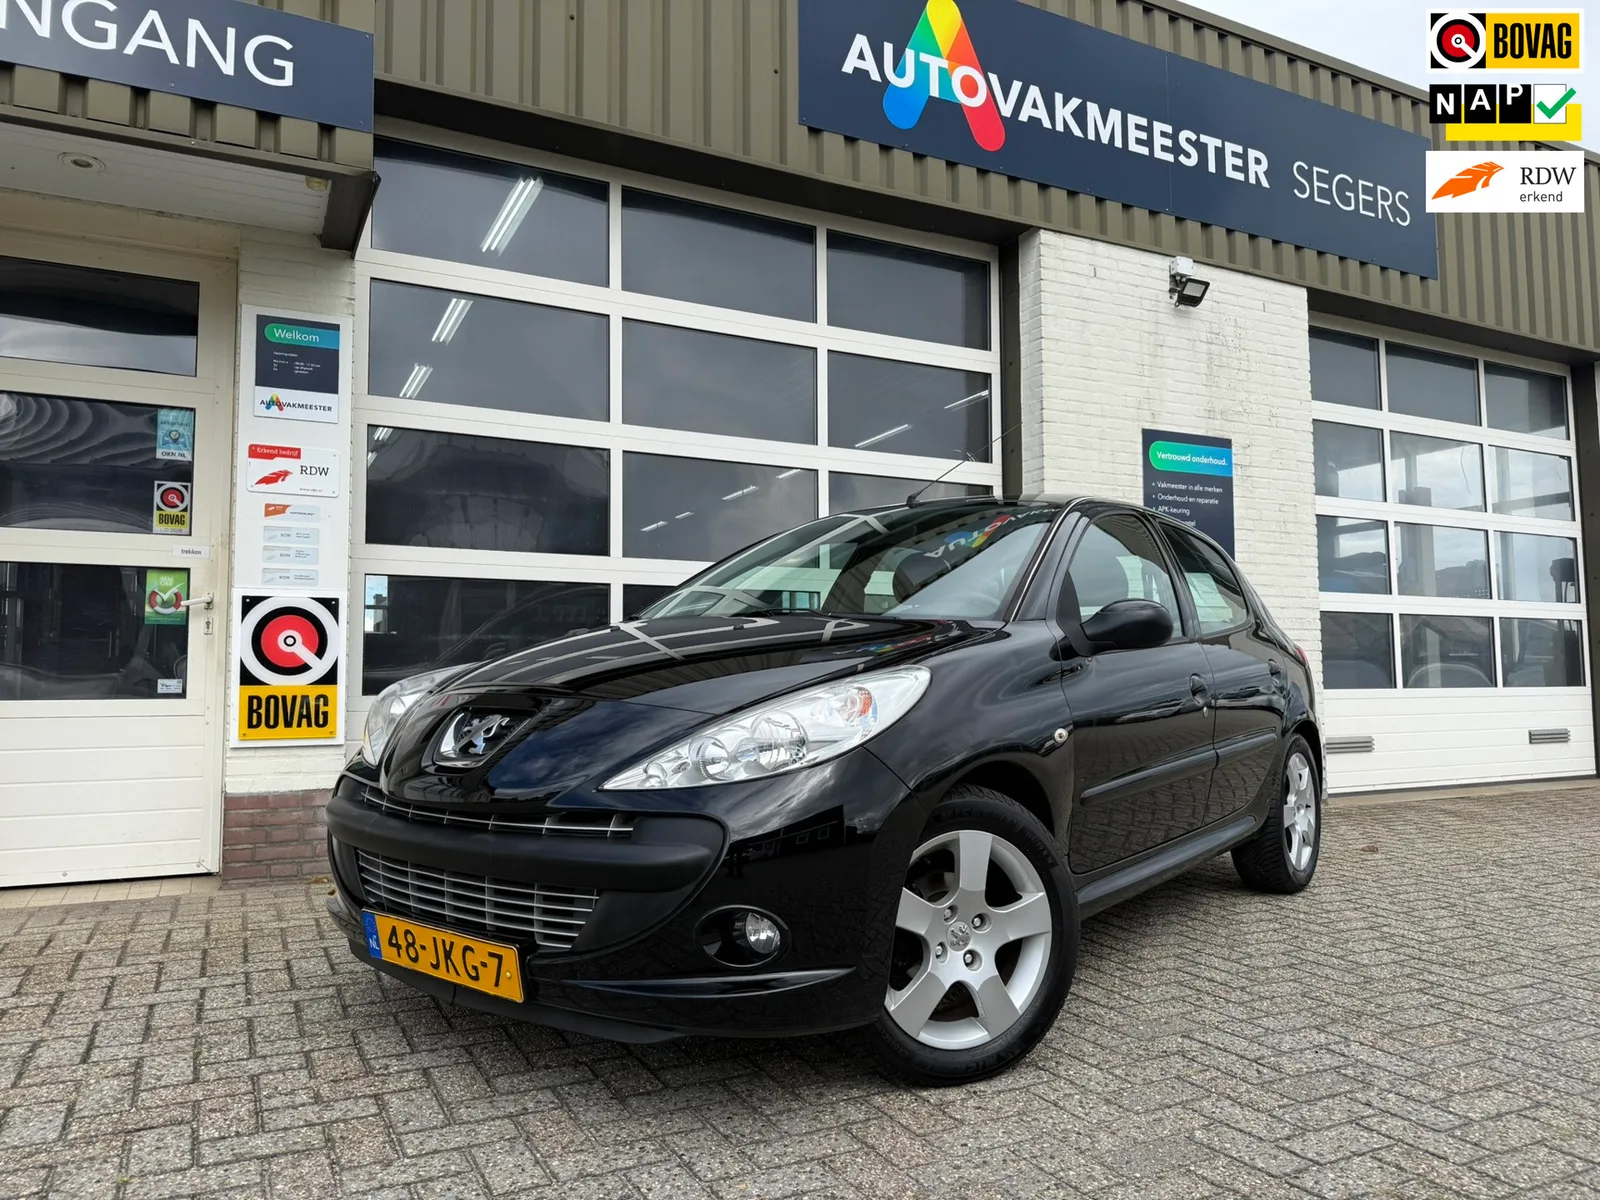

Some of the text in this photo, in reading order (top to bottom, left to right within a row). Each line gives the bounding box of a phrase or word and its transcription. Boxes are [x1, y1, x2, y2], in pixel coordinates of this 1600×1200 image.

[841, 33, 1411, 227] AUTOVAKMEESTER SEGERS
[273, 328, 320, 342] Welkom
[259, 399, 333, 412] AUTOVAKMEESTER
[256, 447, 299, 457] Erkend bedrijf
[1156, 451, 1228, 466] Vertrouwd onderhoud.
[300, 465, 330, 476] RDW
[1156, 481, 1187, 490] Vakmeester
[1157, 493, 1188, 502] Onderhoud
[1196, 497, 1219, 505] reparatie
[1157, 506, 1190, 516] APK-keuring
[158, 513, 186, 526] BOVAG
[247, 693, 329, 729] BOVAG
[369, 938, 380, 951] NL
[388, 925, 504, 987] 48-JKG-7
